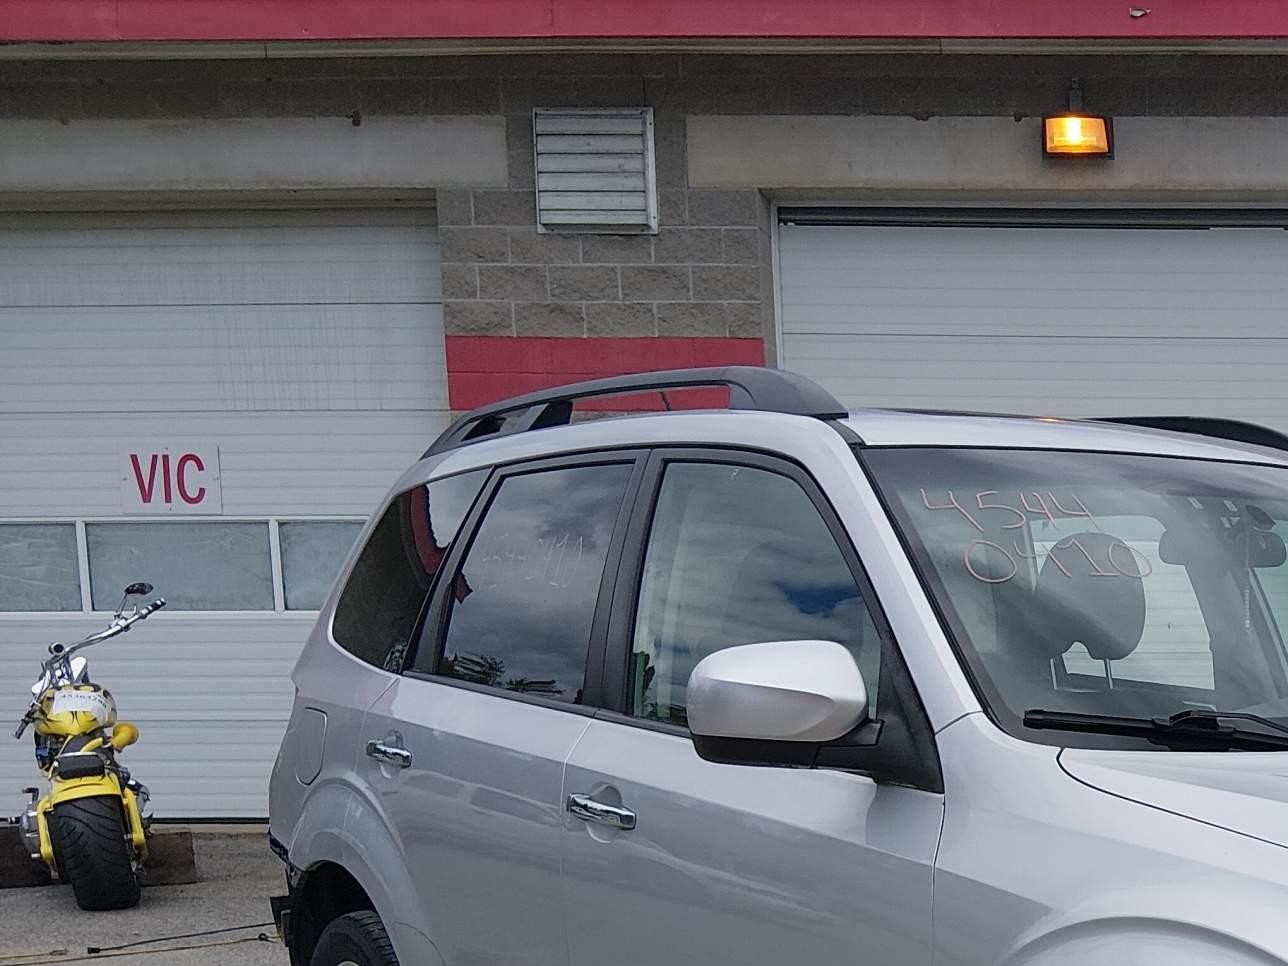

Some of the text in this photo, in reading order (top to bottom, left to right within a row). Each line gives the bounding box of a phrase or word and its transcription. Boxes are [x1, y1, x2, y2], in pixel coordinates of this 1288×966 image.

[128, 453, 206, 504] VIC
[920, 488, 1101, 532] 4544
[964, 539, 1153, 584] 0410
